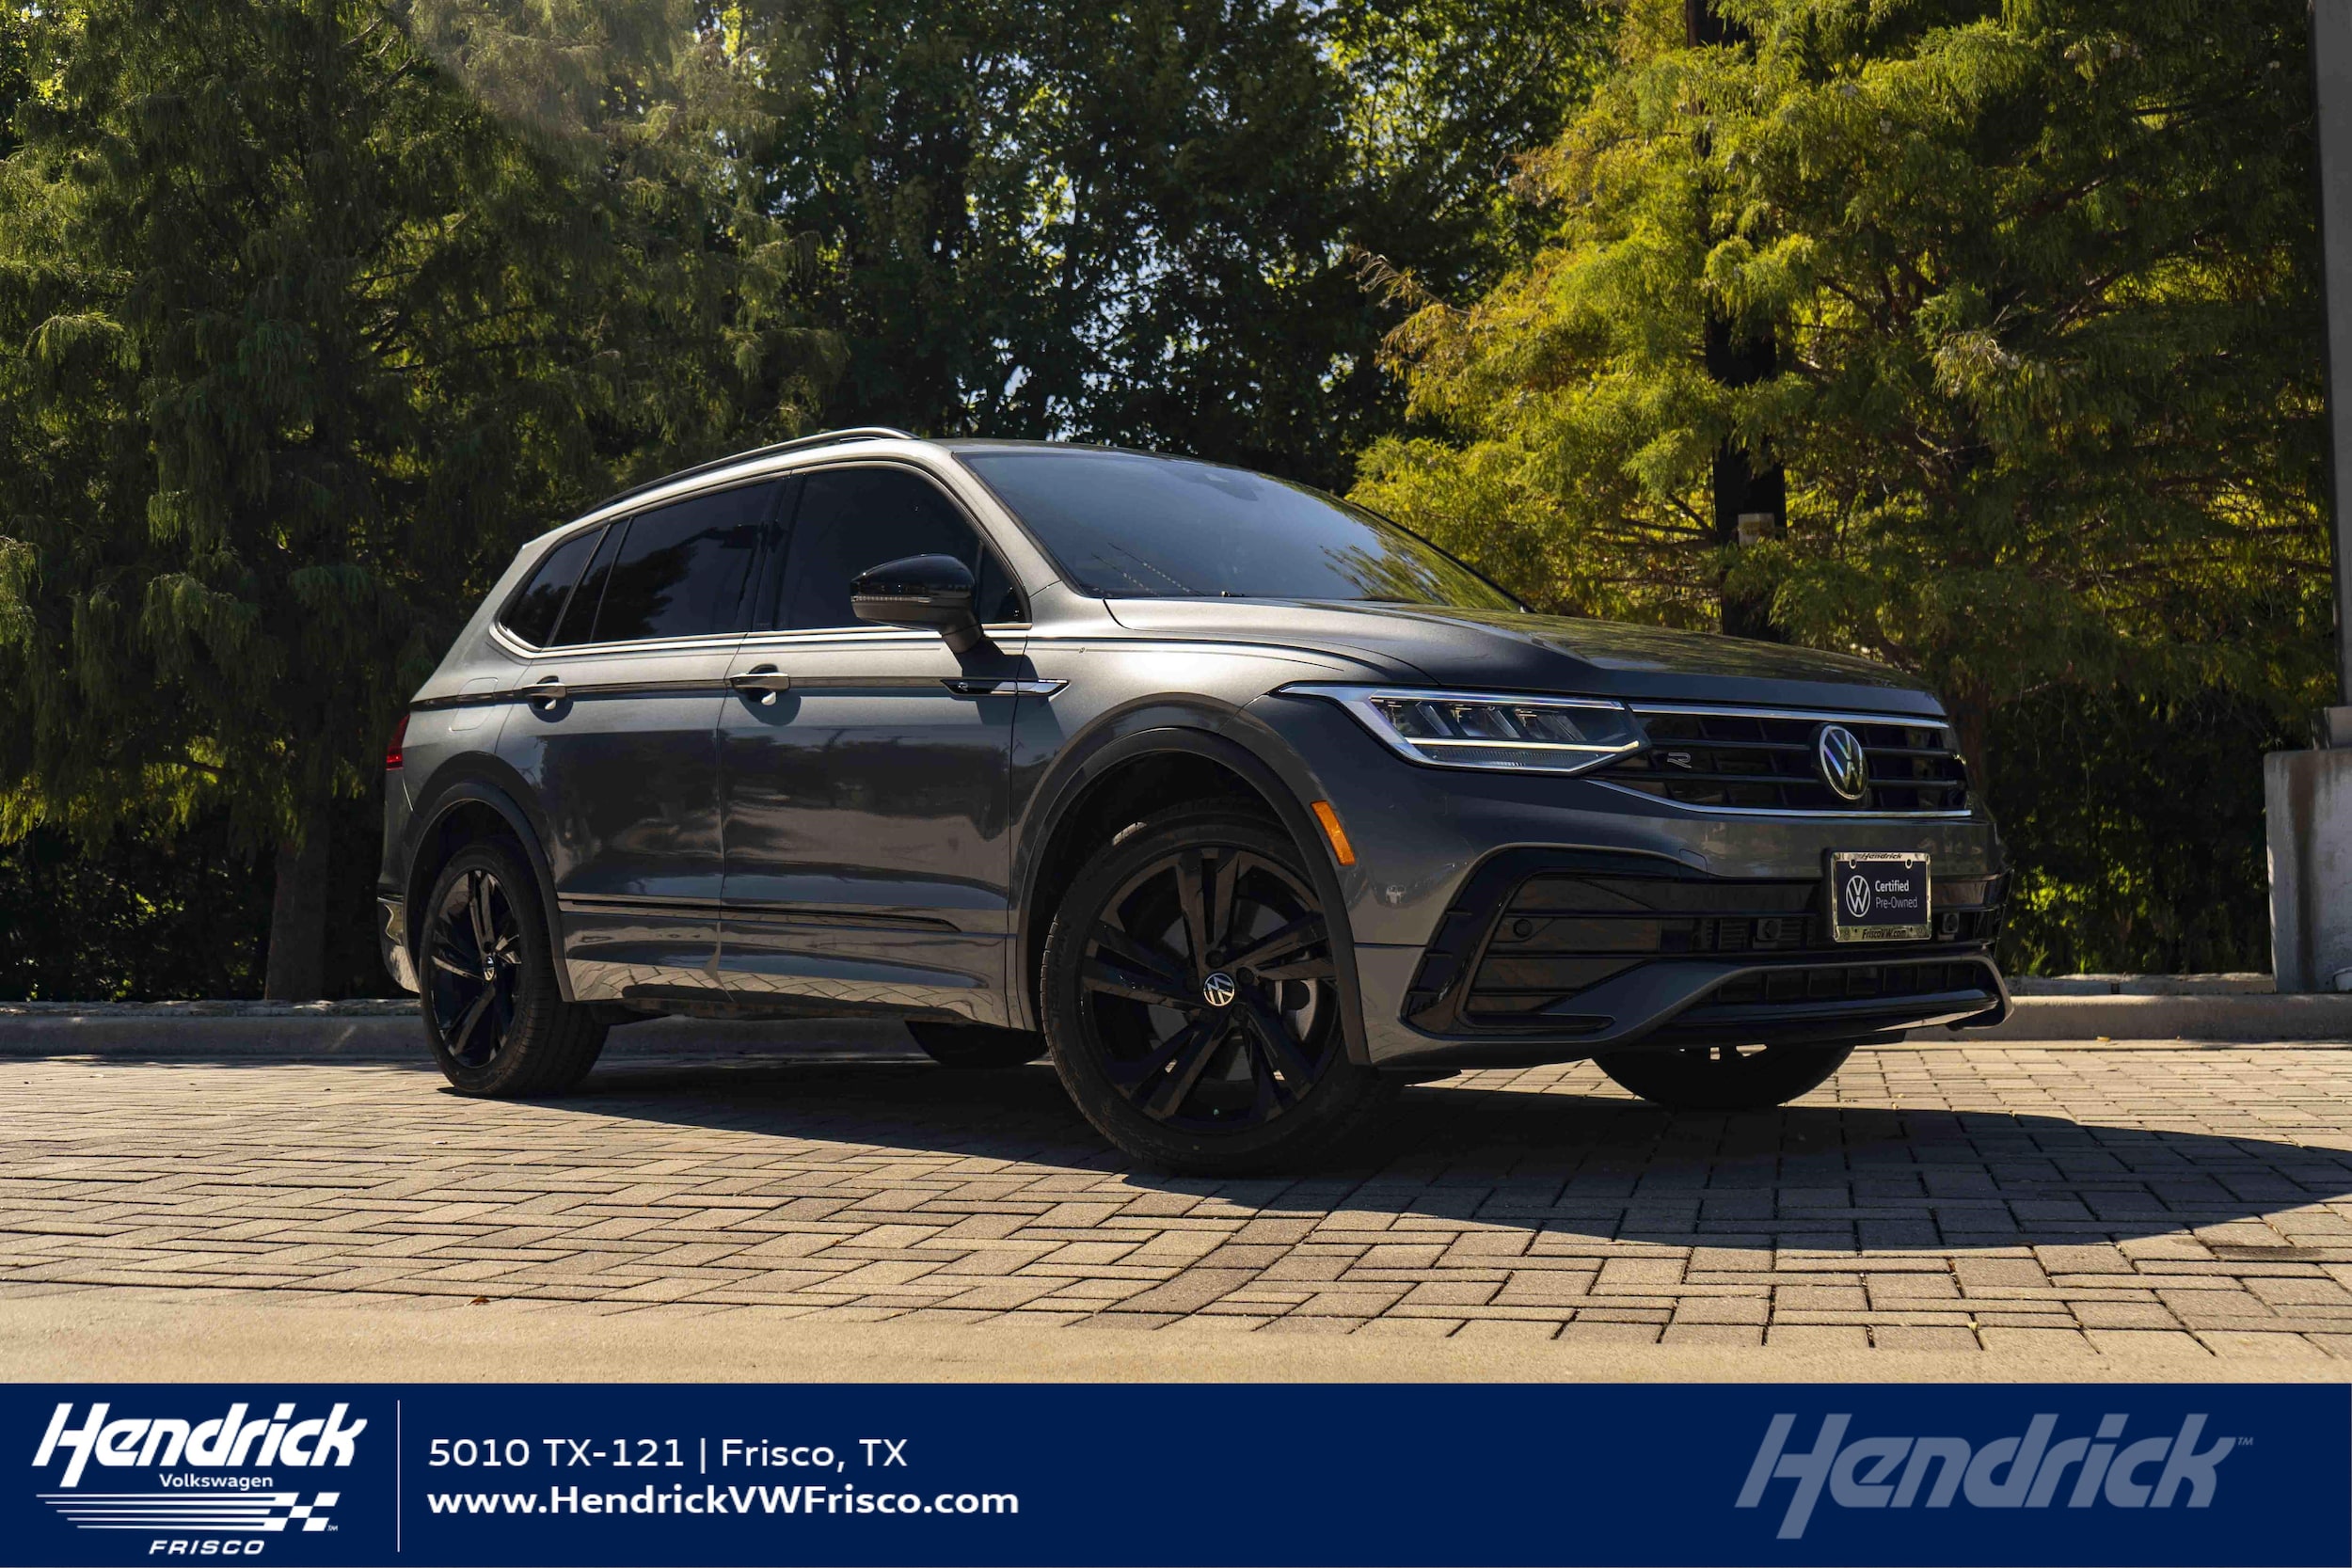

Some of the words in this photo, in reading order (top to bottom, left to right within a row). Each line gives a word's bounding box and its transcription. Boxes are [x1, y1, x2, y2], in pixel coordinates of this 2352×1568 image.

[1666, 752, 1692, 768] R
[1861, 852, 1902, 861] Hendrick
[1874, 879, 1910, 893] Certified
[1875, 896, 1918, 910] Pre-Owned
[1862, 927, 1907, 940] FriscoVW.com
